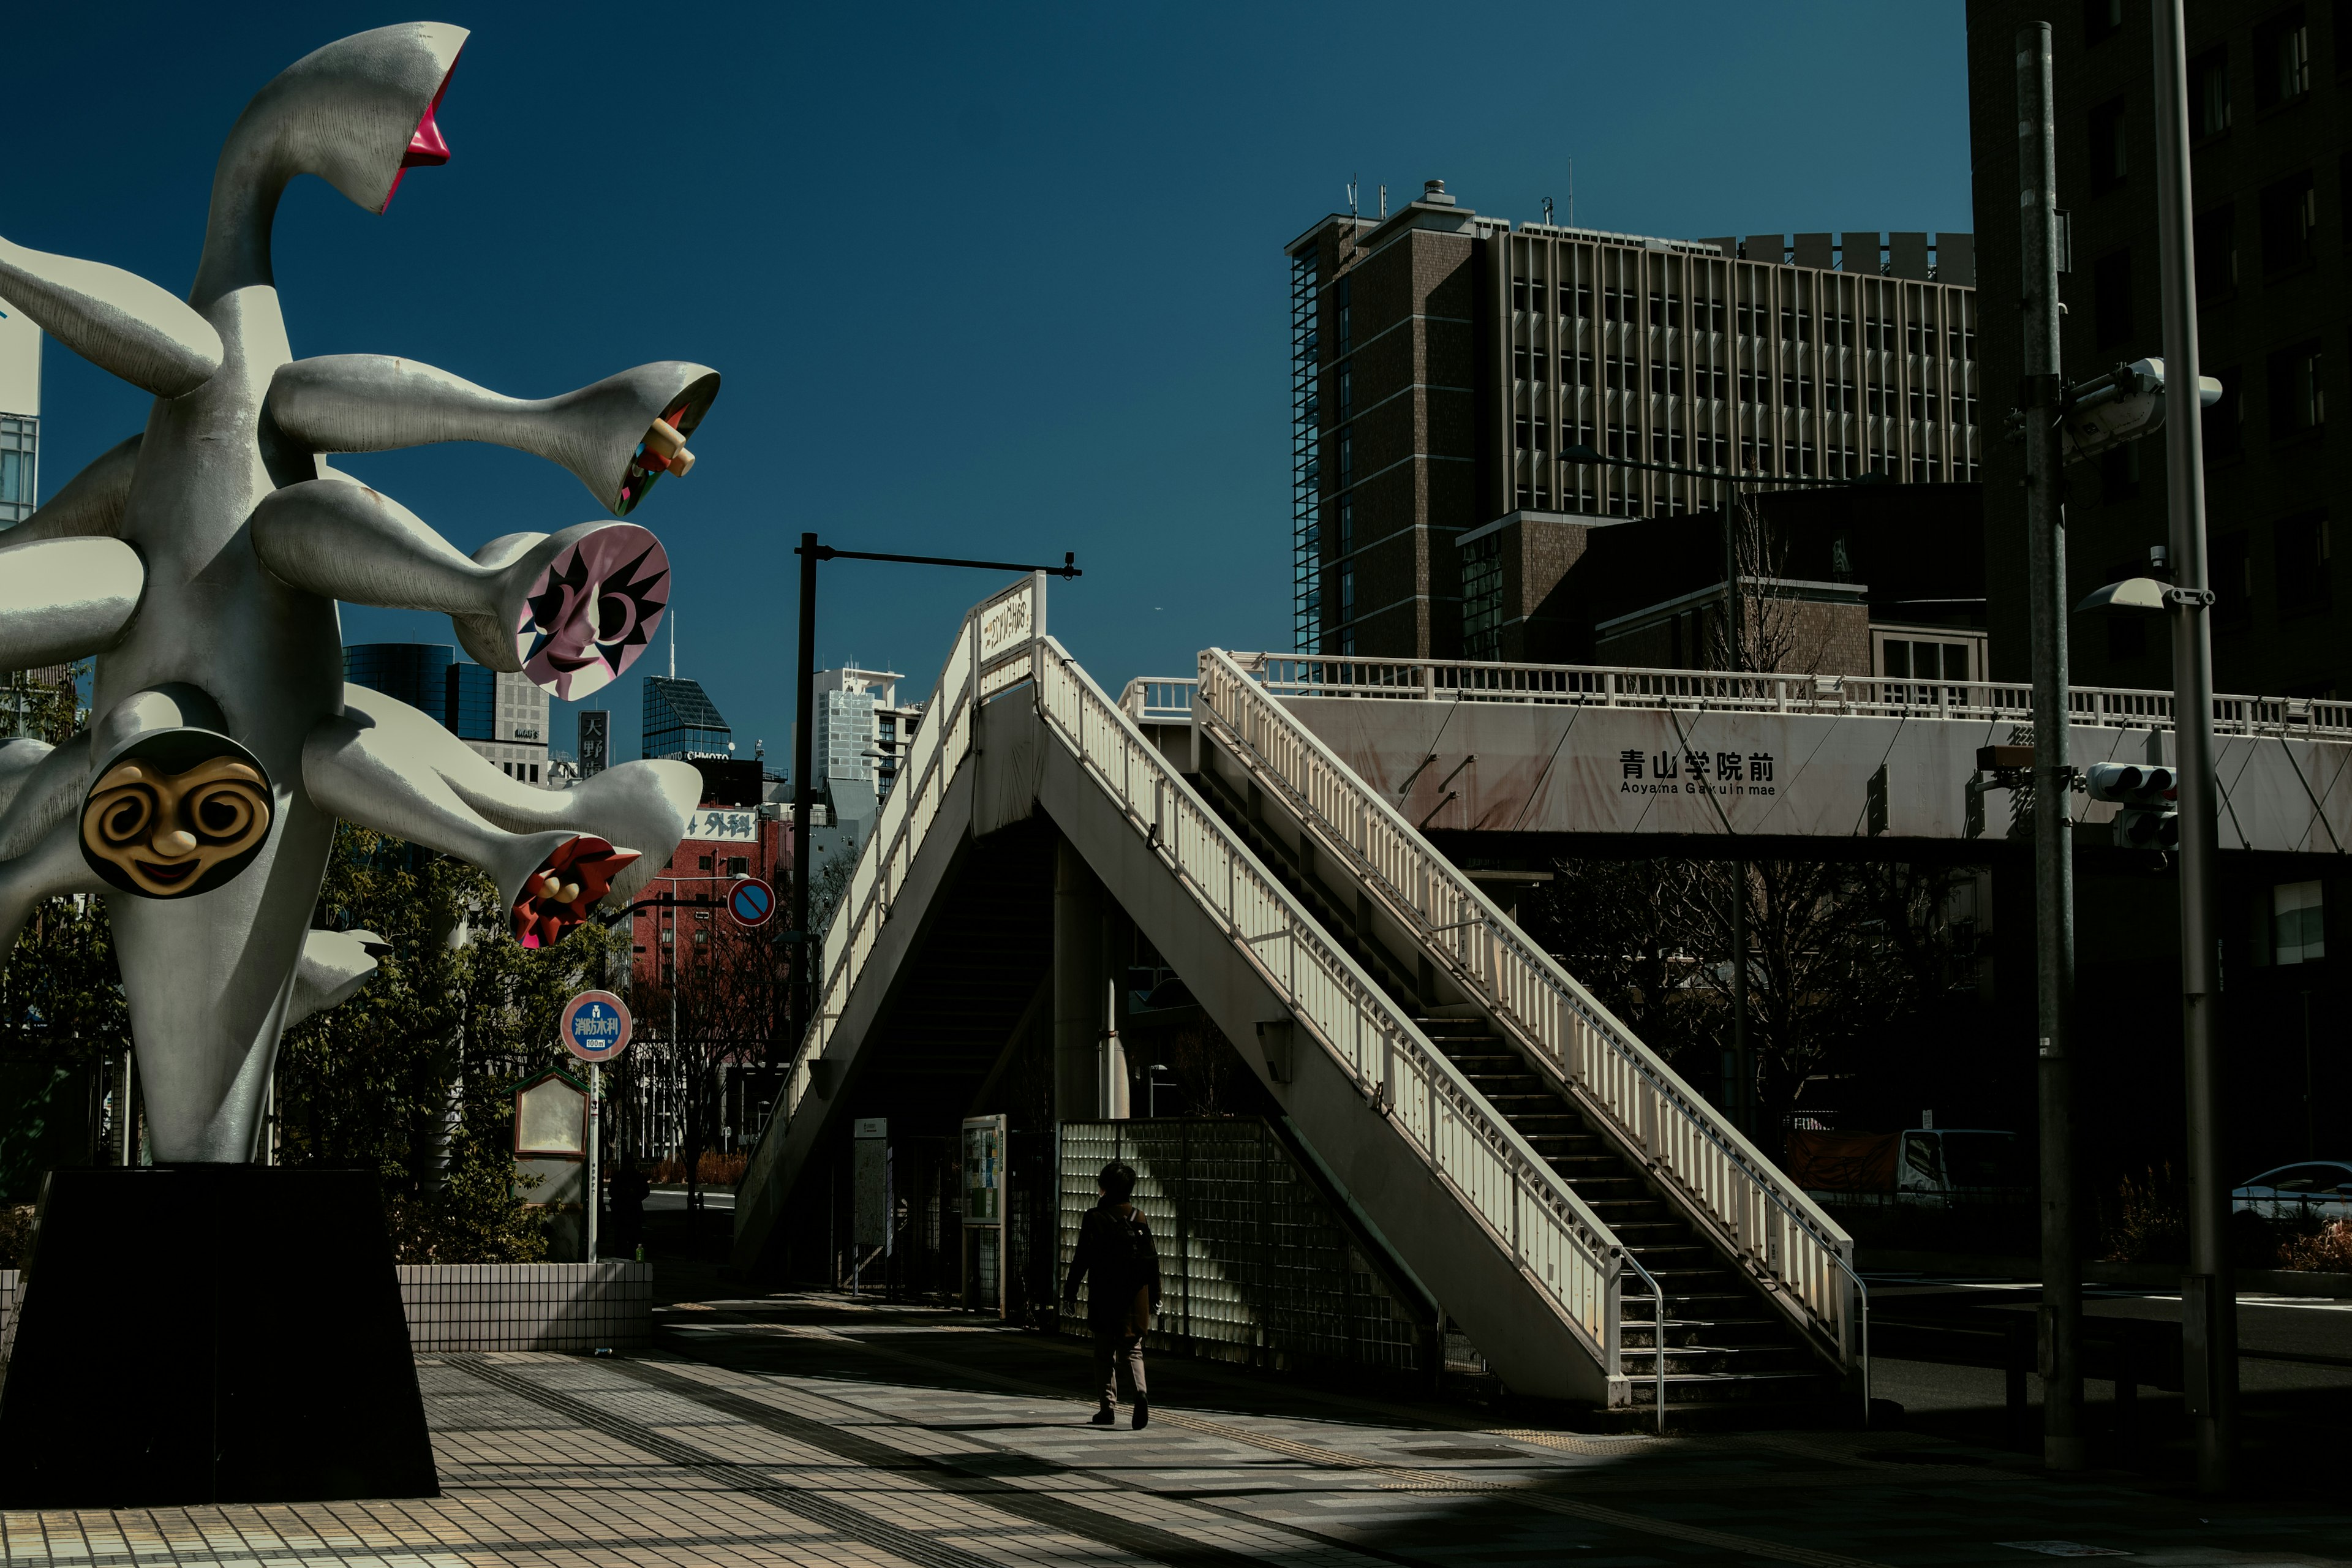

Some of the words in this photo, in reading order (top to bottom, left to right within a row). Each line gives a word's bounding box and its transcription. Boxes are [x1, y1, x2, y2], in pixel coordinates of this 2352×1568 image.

[583, 718, 603, 778] 天野歯
[1620, 749, 1773, 781] 青山学院前
[1621, 782, 1678, 794] Aoyama
[1686, 783, 1743, 794] Gakuin
[1749, 786, 1775, 795] mae
[575, 1017, 618, 1036] 消防水利
